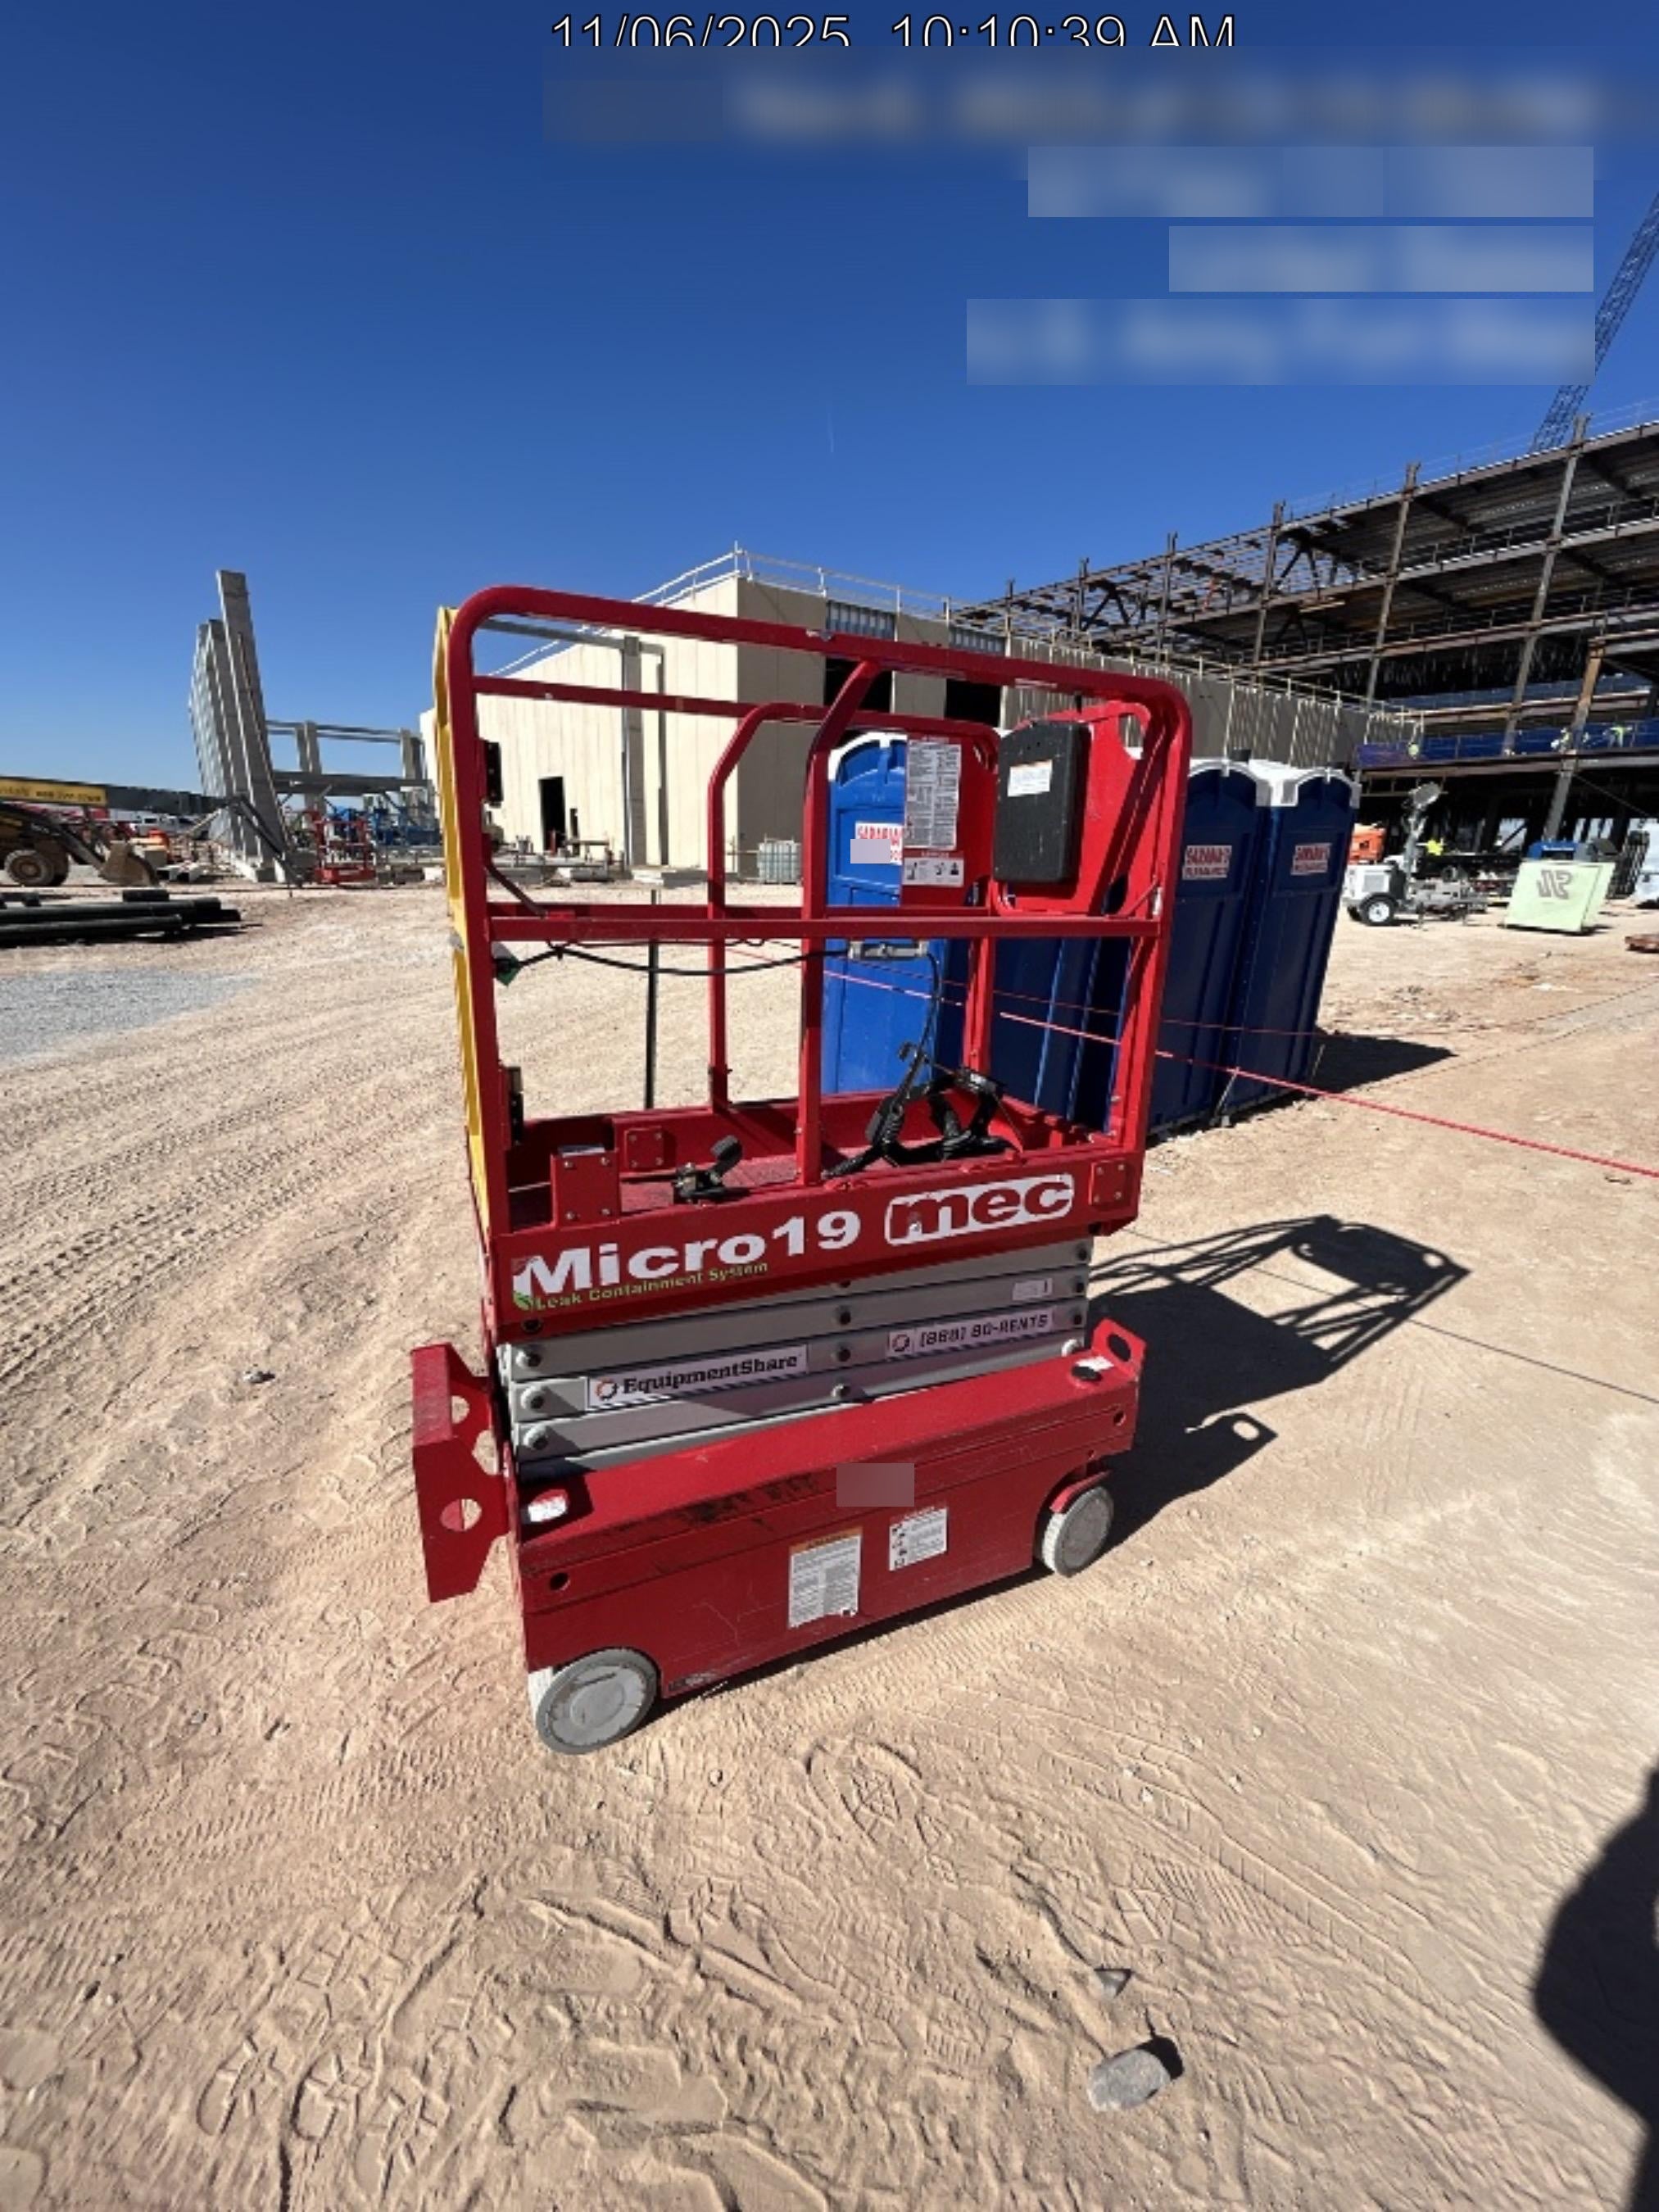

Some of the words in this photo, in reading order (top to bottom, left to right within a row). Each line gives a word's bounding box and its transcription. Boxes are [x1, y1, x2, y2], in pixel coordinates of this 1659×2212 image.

[889, 1181, 1072, 1240] mec
[513, 1209, 860, 1294] Micro19
[536, 1292, 582, 1311] Leak
[589, 1272, 702, 1301] Containment
[709, 1262, 768, 1282] System
[623, 1355, 799, 1394] EquipmentShare
